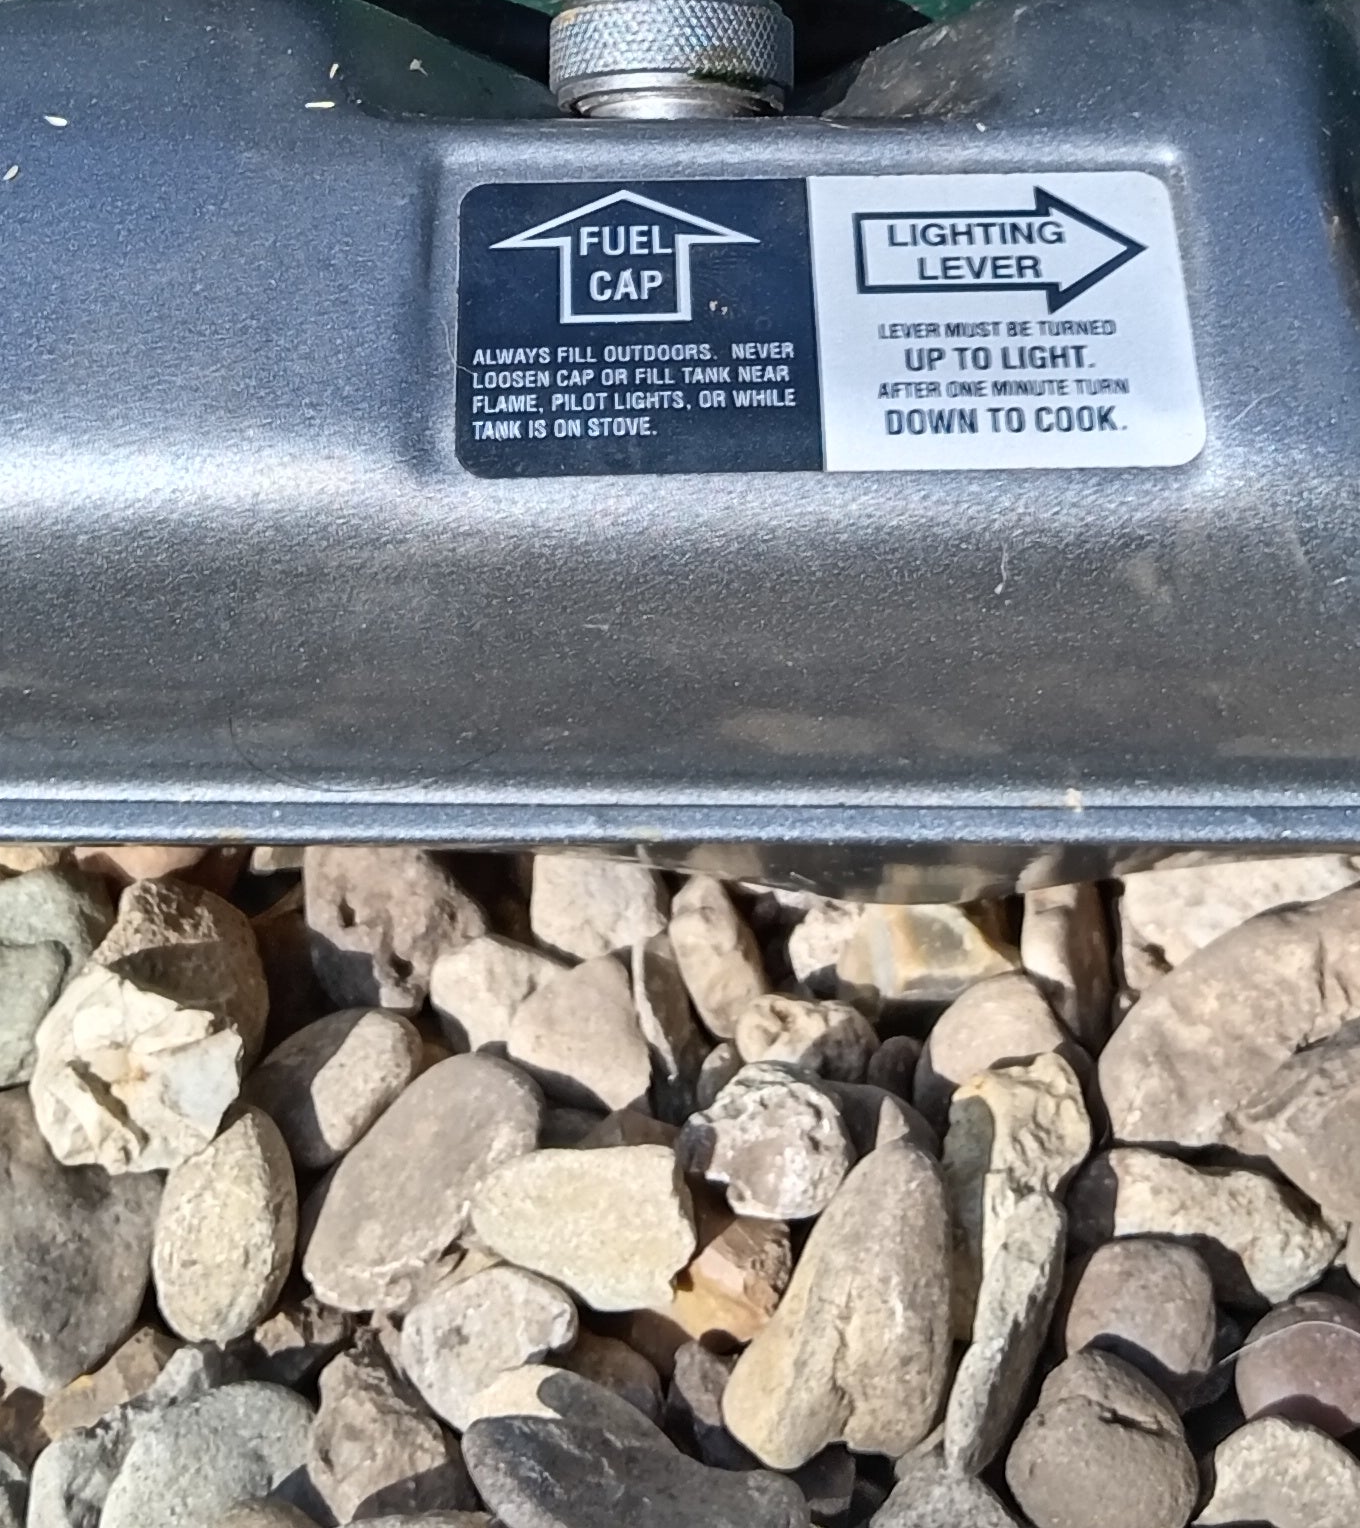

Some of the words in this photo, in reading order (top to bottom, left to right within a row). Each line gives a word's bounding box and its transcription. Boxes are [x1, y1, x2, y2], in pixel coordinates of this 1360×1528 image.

[579, 225, 673, 256] FUEL
[887, 220, 1067, 247] LIGHTING
[917, 254, 1042, 281] LEVER
[590, 269, 663, 301] CAP
[878, 322, 940, 339] LEVER
[945, 321, 1001, 338] MUST
[1008, 321, 1032, 337] BE
[1040, 320, 1117, 336] TURNED
[473, 346, 551, 366] ALWAYS
[557, 346, 597, 363] FILL
[603, 343, 718, 362] OUTDOORS.
[731, 341, 794, 360] NEVER
[904, 347, 946, 372] UP
[956, 346, 992, 371] TO
[1001, 344, 1096, 370] LIGHT.
[473, 370, 550, 389] LOOSEN
[556, 369, 595, 387] CAP
[601, 368, 628, 386] OR
[635, 367, 674, 385] FILL
[681, 366, 731, 384] TANK
[738, 365, 790, 382] NEAR
[877, 382, 942, 400] AFTER
[946, 380, 987, 398] ONE
[991, 379, 1069, 397] MINUTE
[1074, 378, 1130, 395] TURN
[472, 395, 544, 414] FLAME,
[551, 392, 609, 412] PILOT
[613, 391, 692, 411] LIGHTS,
[699, 390, 726, 408] OR
[732, 388, 796, 408] WHILE
[473, 421, 522, 441] TANK
[528, 420, 547, 439] IS
[553, 419, 581, 438] ON
[587, 417, 658, 437] STOVE.
[885, 408, 979, 436] DOWN
[986, 407, 1025, 433] TO
[1034, 405, 1128, 433] COOK.
